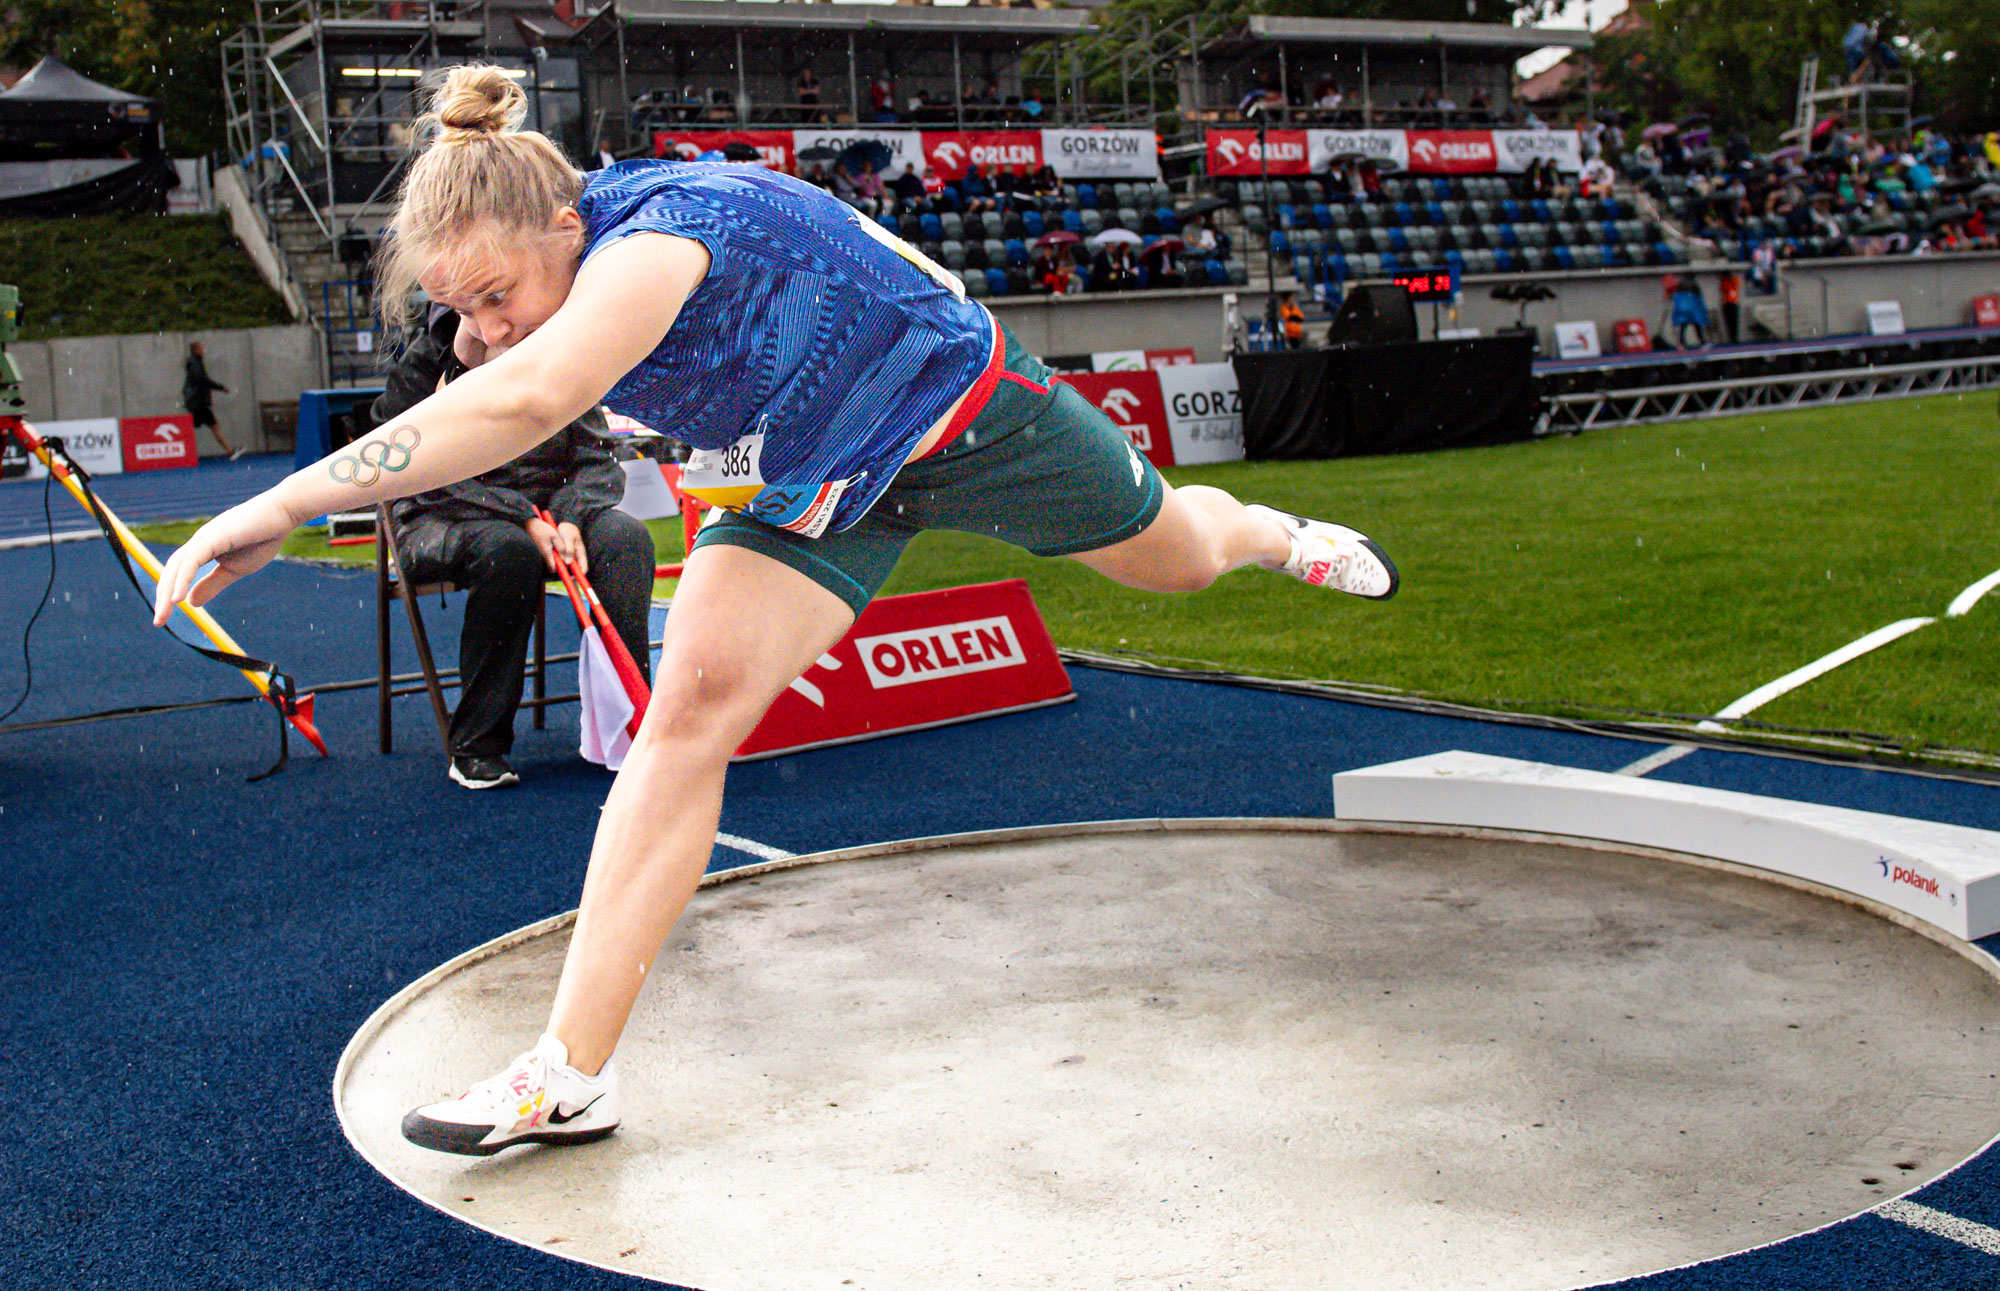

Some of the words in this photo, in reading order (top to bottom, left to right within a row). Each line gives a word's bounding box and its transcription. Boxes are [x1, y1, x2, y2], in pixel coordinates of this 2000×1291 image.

[971, 144, 1035, 164] ORLEN
[1061, 132, 1140, 154] GORZÓW
[1249, 143, 1303, 160] ORLEN
[1173, 391, 1242, 417] GORZ
[139, 445, 182, 458] ORLEN
[721, 444, 753, 478] 386
[805, 513, 826, 536] OLSKI
[824, 488, 840, 512] 2023
[872, 626, 1013, 678] ORLEN
[1893, 865, 1940, 898] polanik
